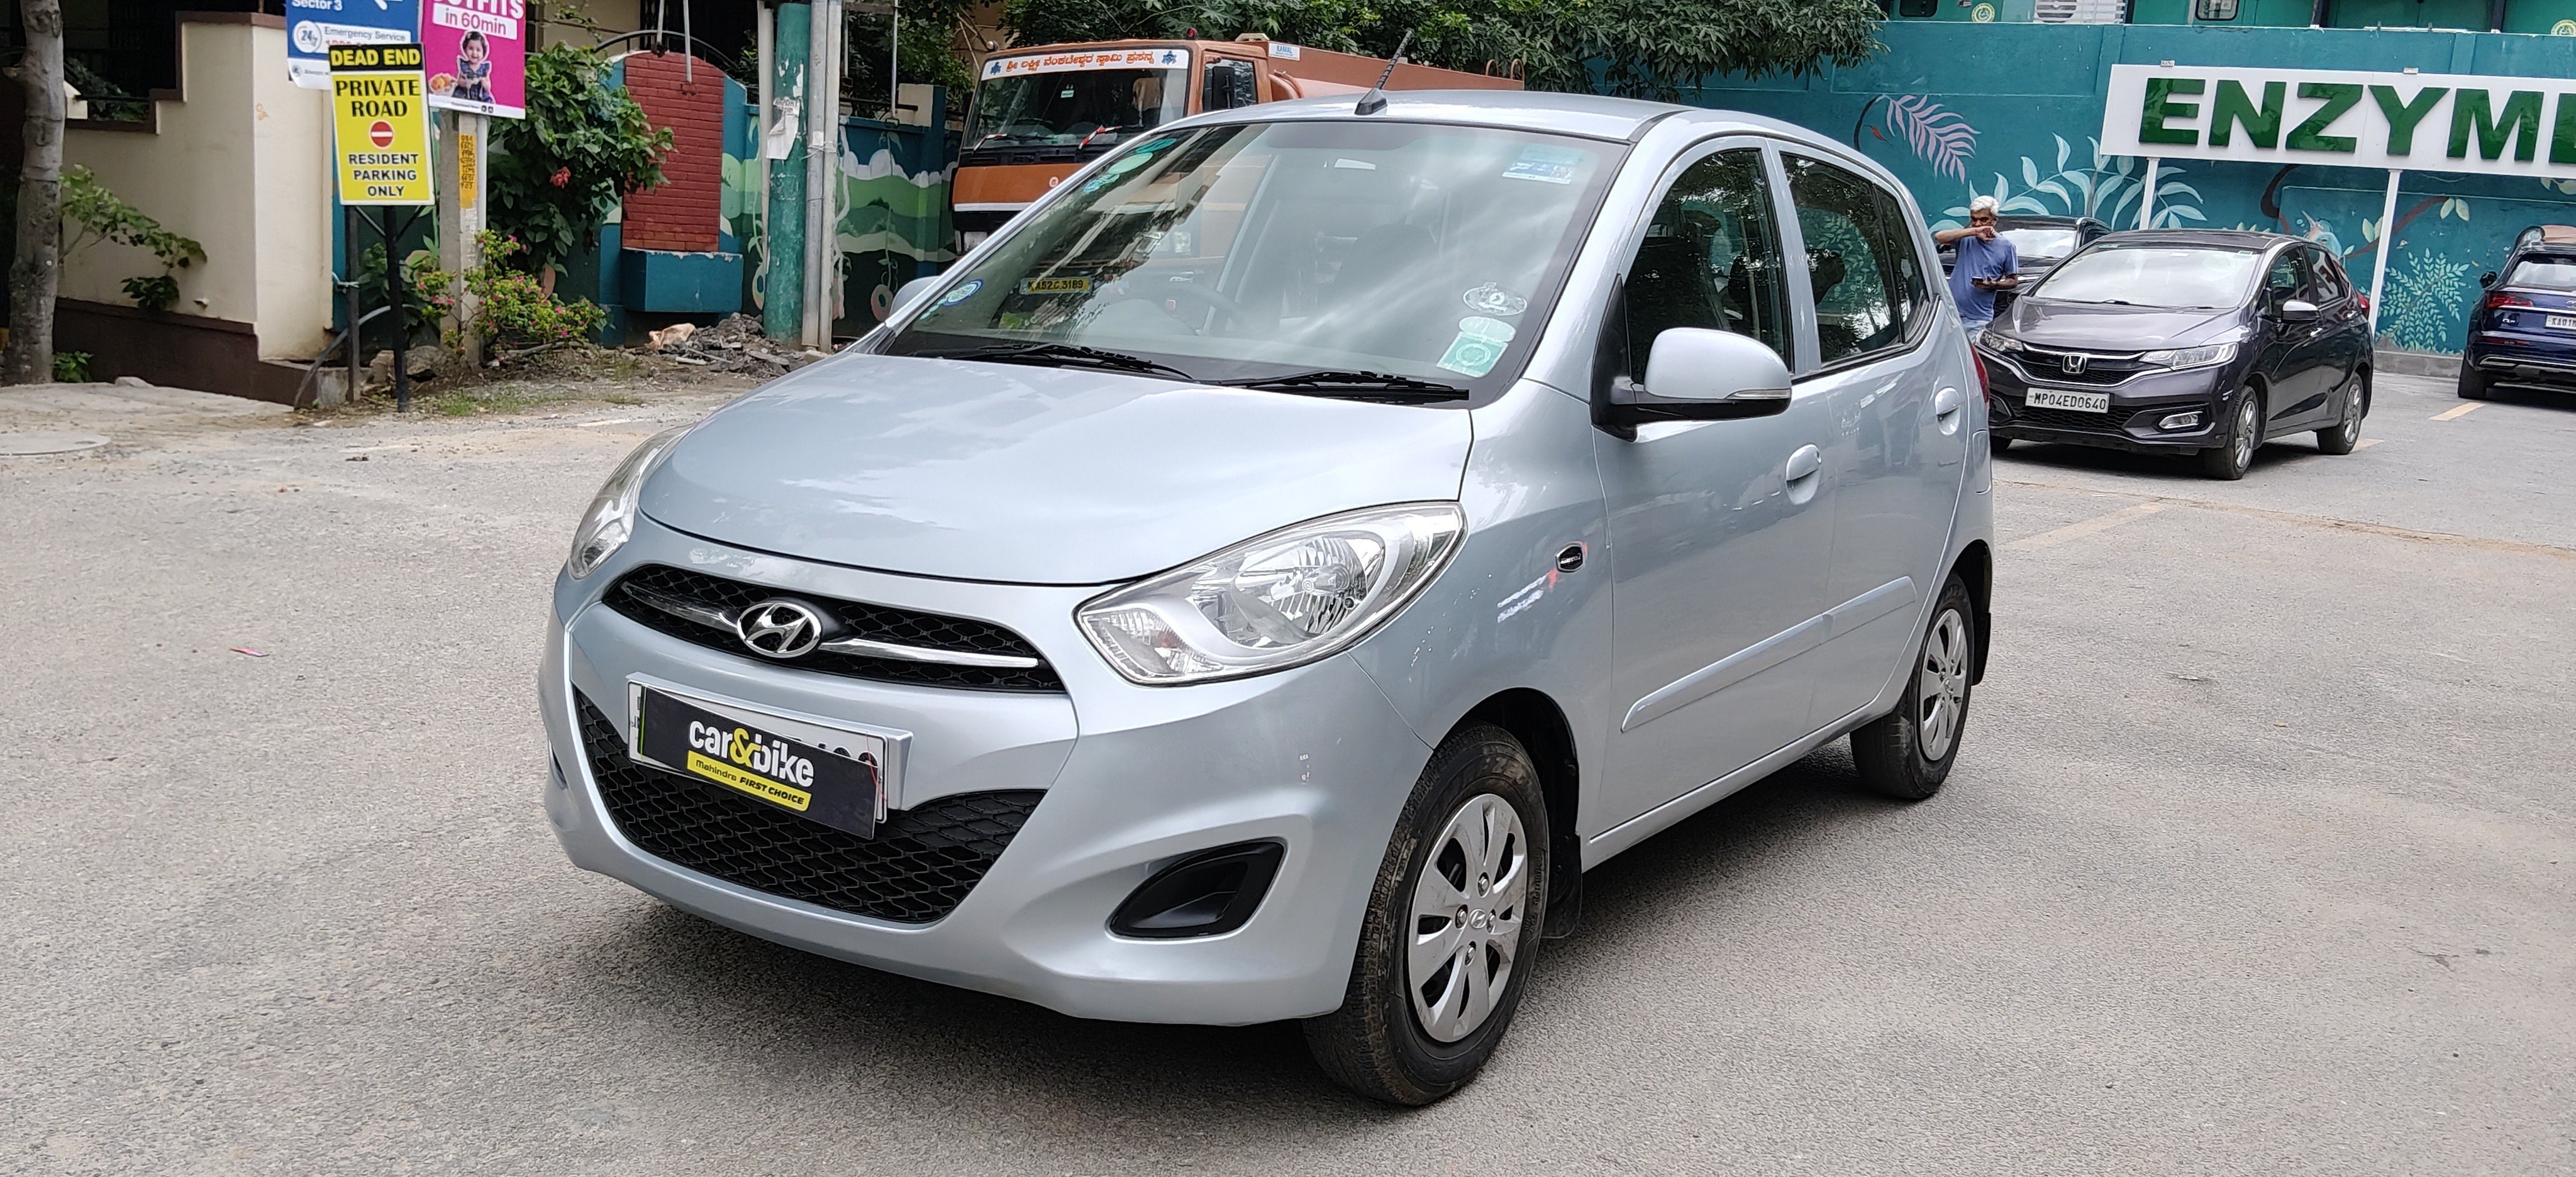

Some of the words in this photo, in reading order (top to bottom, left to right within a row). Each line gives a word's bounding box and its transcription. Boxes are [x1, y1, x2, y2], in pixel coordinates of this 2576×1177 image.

[334, 0, 343, 11] 3
[445, 8, 458, 26] in
[462, 12, 506, 35] 60min
[325, 26, 372, 40] Emergency
[375, 31, 406, 41] Service
[330, 48, 379, 66] DEAD
[383, 48, 421, 65] END
[335, 79, 421, 96] PRIVATE
[351, 100, 408, 117] ROAD
[348, 154, 418, 165] RESIDENT
[353, 170, 417, 180] PARKING
[367, 185, 404, 196] ONLY
[2033, 392, 2107, 410] MP04ED0640
[739, 776, 768, 792] FIRST
[768, 787, 805, 805] CHOICE
